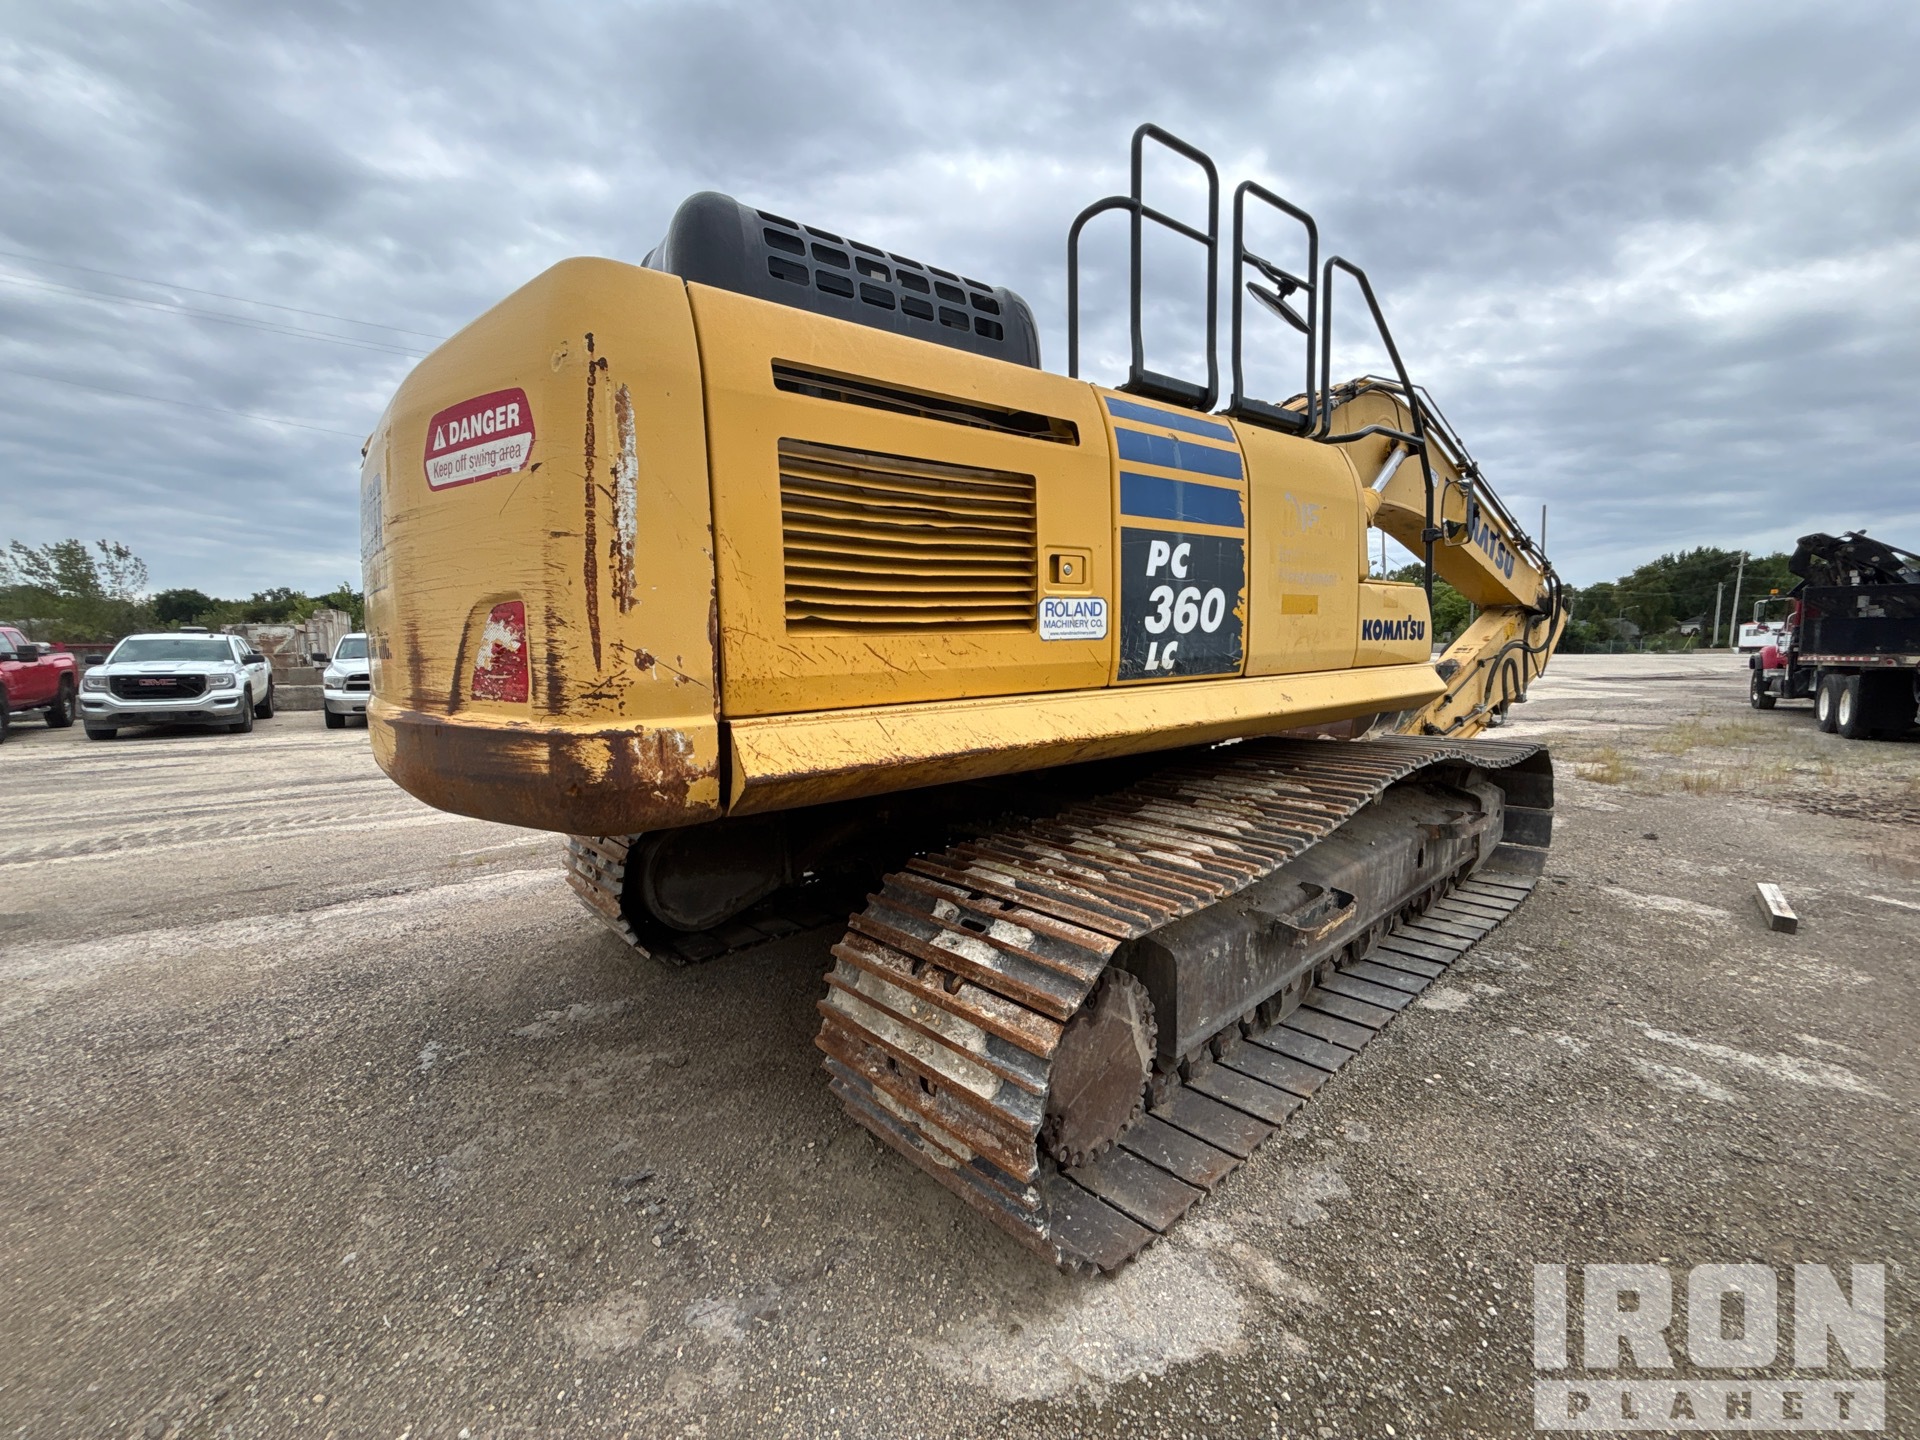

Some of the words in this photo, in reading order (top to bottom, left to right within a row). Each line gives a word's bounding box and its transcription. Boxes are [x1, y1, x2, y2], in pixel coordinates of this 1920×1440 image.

[449, 402, 520, 446] DANGER
[433, 460, 453, 479] Keep
[455, 453, 468, 473] off
[469, 448, 497, 468] swing
[499, 443, 522, 463] area
[1145, 539, 1192, 579] PC
[1043, 619, 1090, 629] MACHINERY
[1090, 618, 1104, 628] CO.
[1045, 601, 1103, 618] ROLAND
[1144, 585, 1226, 634] 360
[1361, 614, 1425, 641] KOMATSU
[1144, 640, 1179, 670] LC
[138, 678, 178, 686] GMC
